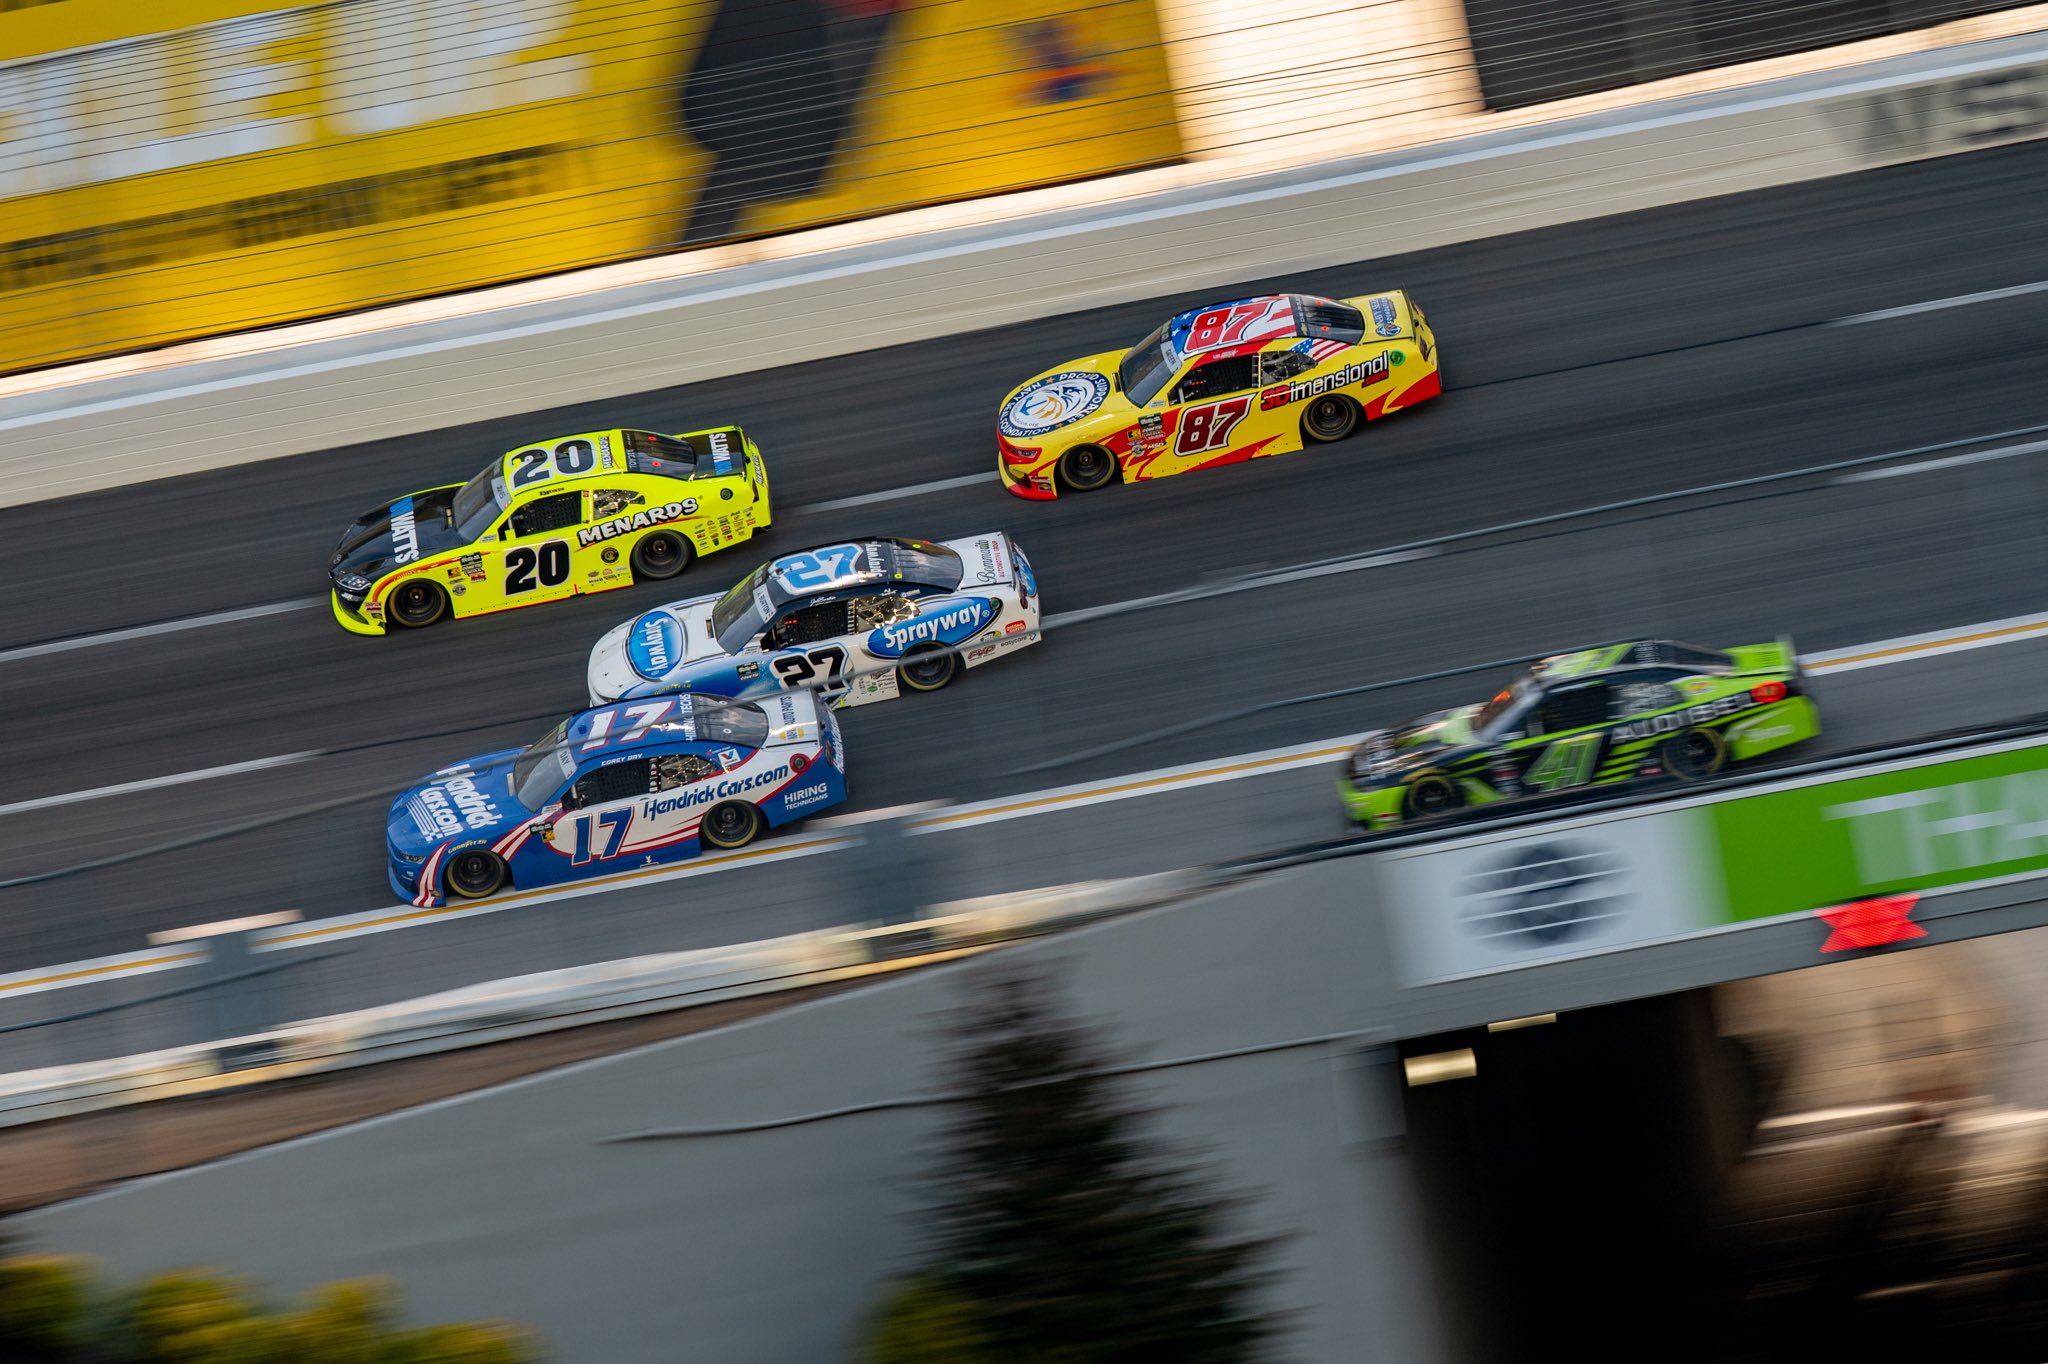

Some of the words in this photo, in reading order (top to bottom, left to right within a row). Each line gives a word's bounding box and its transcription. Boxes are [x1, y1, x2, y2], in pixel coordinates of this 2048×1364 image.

[1184, 301, 1272, 353] 87
[1165, 348, 1177, 365] GREEN
[1013, 381, 1042, 402] NAVY
[1059, 372, 1099, 381] PROUD
[1261, 350, 1389, 411] 3Dimensional
[1362, 370, 1389, 388] .com
[1068, 378, 1108, 423] SUPPORTER
[1000, 419, 1050, 437] FOUNDATION
[1175, 393, 1256, 456] 87
[508, 438, 598, 492] 20
[598, 436, 613, 468] MENARDS
[709, 433, 732, 463] WATTS
[390, 511, 420, 564] WATTS
[577, 498, 698, 547] MENARDS
[865, 542, 887, 577] Sprayway
[976, 540, 997, 584] Bommarito
[992, 541, 1000, 552] GROUP
[504, 539, 571, 597] 20
[769, 544, 862, 594] 27
[994, 553, 1005, 577] AUTOMOTIVE
[760, 595, 771, 615] BURTON
[883, 603, 981, 650] Sprayway
[639, 617, 669, 672] Sprayway
[774, 646, 846, 693] 27
[679, 693, 693, 714] TECHS
[780, 696, 793, 712] PARTS
[580, 700, 675, 753] 17
[560, 750, 571, 766] DAY
[601, 757, 625, 766] COREY
[627, 753, 643, 762] DAY
[430, 764, 503, 830] Hendrick
[643, 785, 715, 821] Hendrick
[717, 764, 789, 798] Cars.com
[784, 782, 828, 804] HIRING
[785, 793, 828, 810] TECHNICIANS
[448, 839, 487, 854] GOODYEAR
[573, 805, 635, 867] 17
